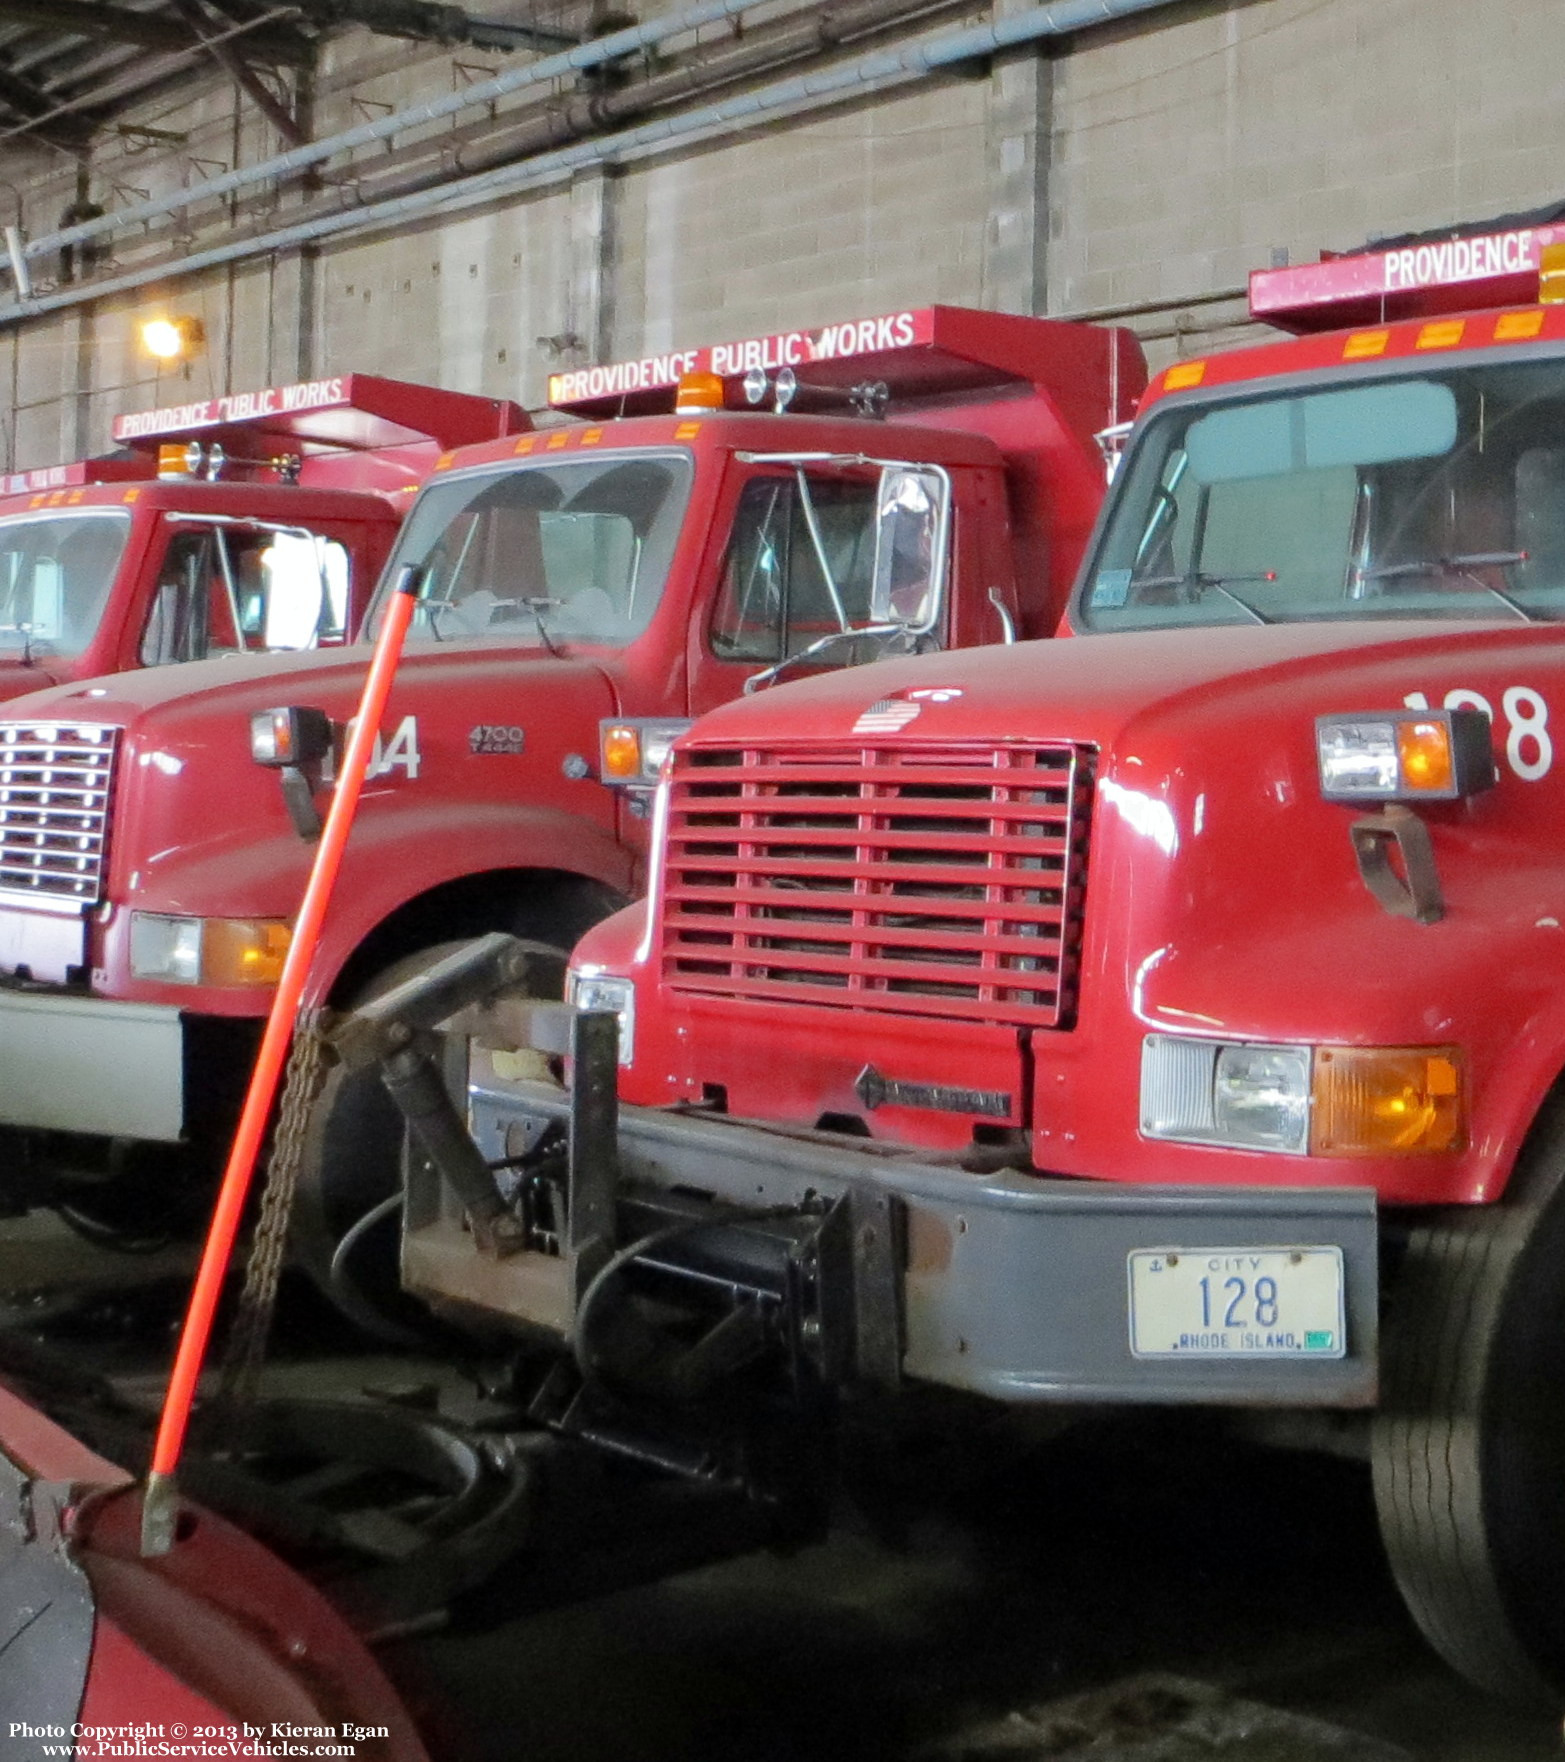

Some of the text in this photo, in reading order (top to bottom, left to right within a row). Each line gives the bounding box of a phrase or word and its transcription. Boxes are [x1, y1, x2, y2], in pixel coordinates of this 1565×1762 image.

[1384, 231, 1533, 288] PROVIDENCE
[562, 313, 914, 400] PROVIDENCE PUBLIC WORKS
[121, 378, 343, 434] PROVIDENCE PUBLIC WORKS
[469, 725, 524, 742] 4700
[1208, 1259, 1261, 1271] CITY
[1199, 1276, 1278, 1327] 128
[1180, 1333, 1295, 1349] RHODE ISLAND
